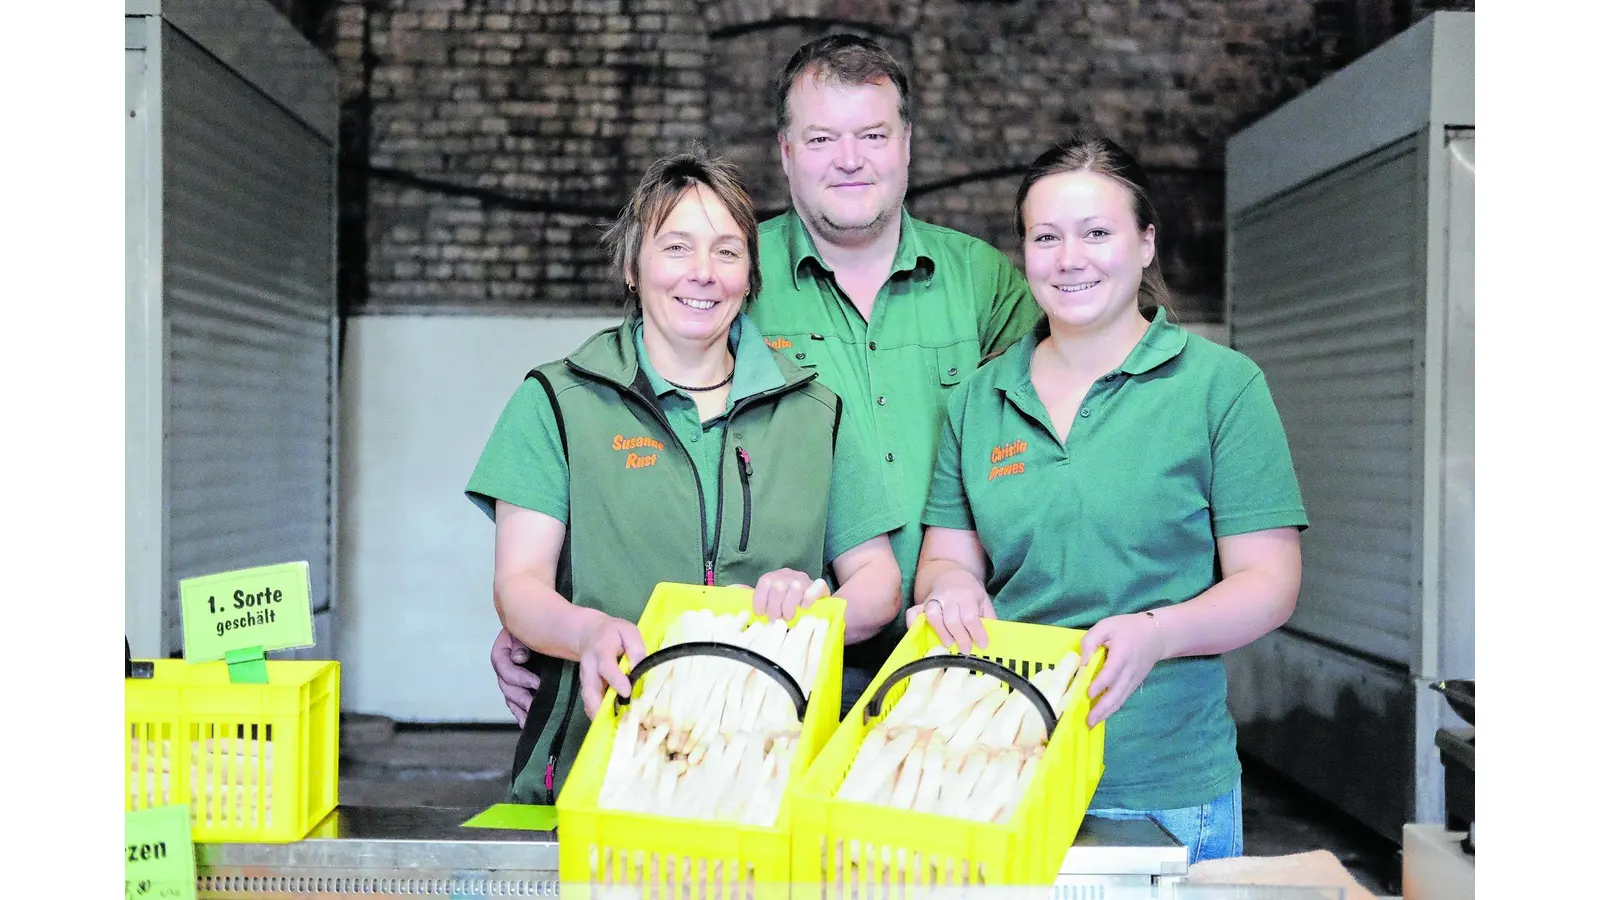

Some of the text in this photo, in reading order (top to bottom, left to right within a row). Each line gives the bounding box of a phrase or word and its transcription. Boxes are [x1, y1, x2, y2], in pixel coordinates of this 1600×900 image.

[612, 434, 665, 451] Susanne
[991, 440, 1028, 464] Christin
[625, 452, 657, 469] Rust
[988, 462, 1025, 482] Drewes
[207, 587, 282, 614] 1. Sorte
[216, 608, 275, 637] geschält
[125, 842, 167, 862] zen
